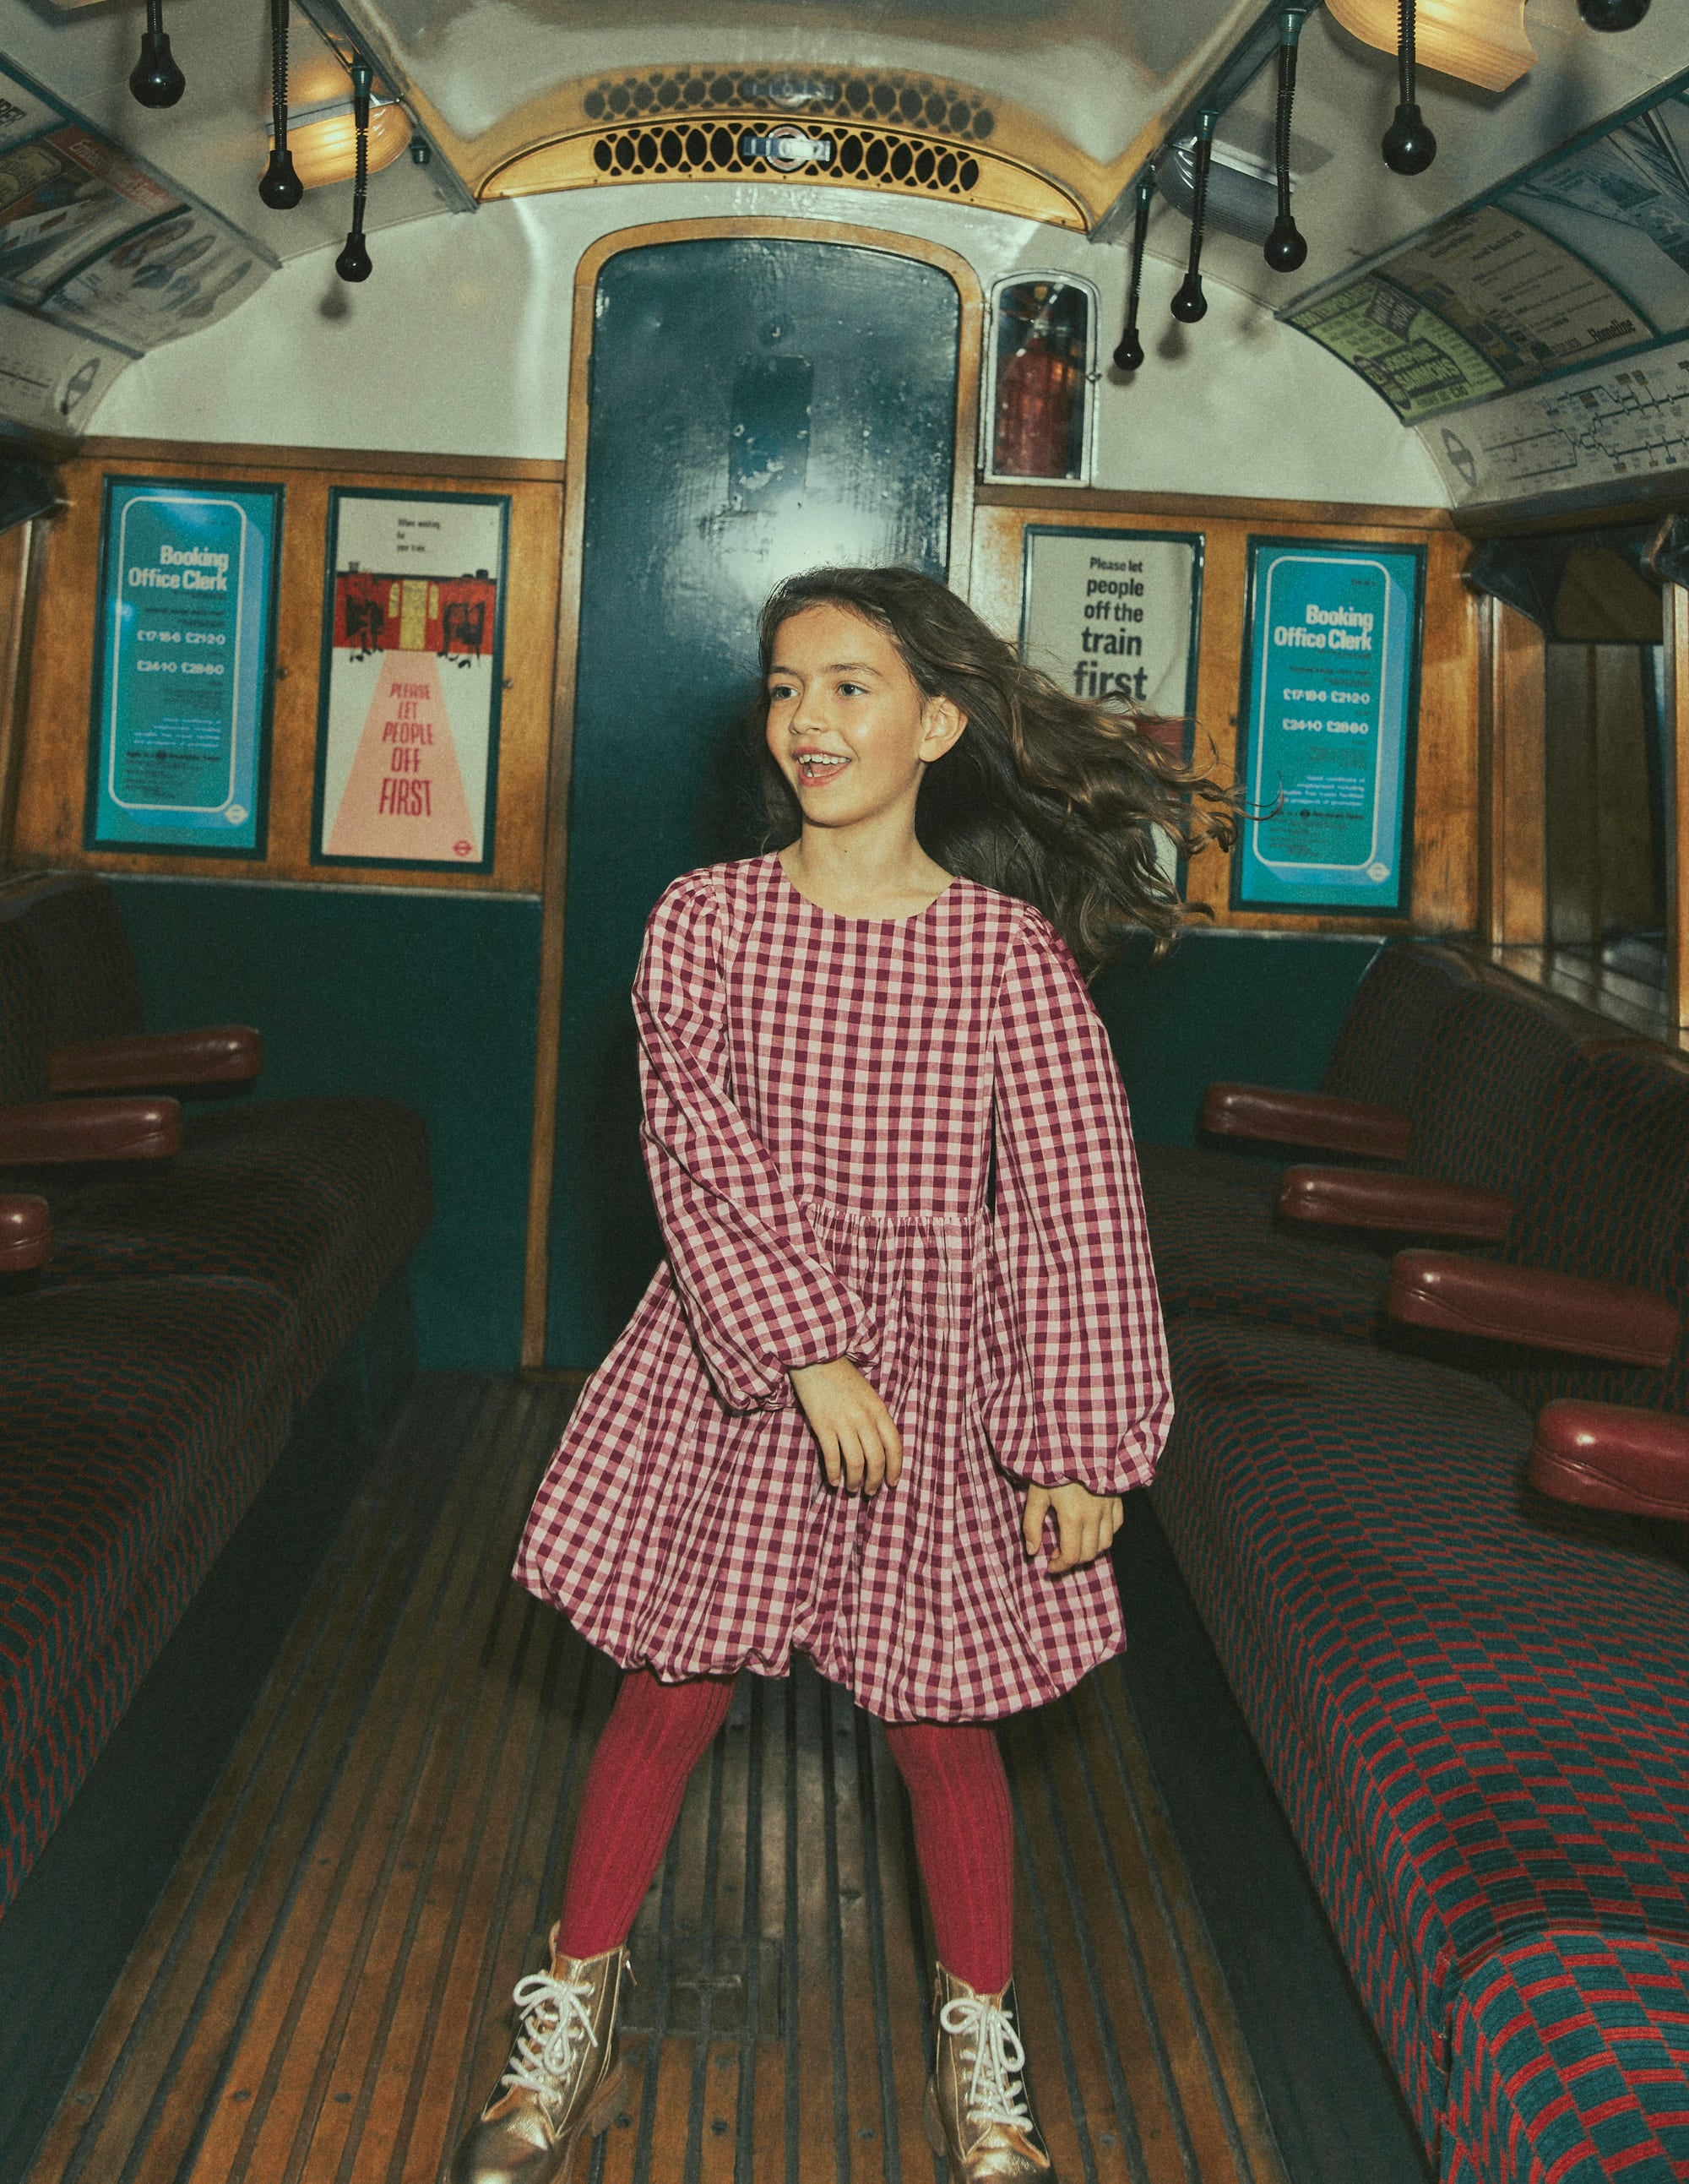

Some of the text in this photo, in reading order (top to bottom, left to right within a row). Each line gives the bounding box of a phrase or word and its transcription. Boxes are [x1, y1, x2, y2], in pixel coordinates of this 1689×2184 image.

[160, 545, 229, 572] Booking
[1089, 557, 1143, 573] Please let
[128, 567, 227, 591] Office Clerk
[1087, 578, 1144, 599] people
[1084, 600, 1143, 622] off the
[1306, 604, 1373, 632] Booking
[1081, 627, 1143, 656] train
[1274, 626, 1371, 650] Office Clerk
[389, 683, 430, 700] PLEASE
[1073, 660, 1149, 702] first
[398, 701, 418, 719] LET
[383, 721, 432, 746] PEOPLE
[391, 747, 421, 773] OFF
[378, 778, 432, 818] FIRST
